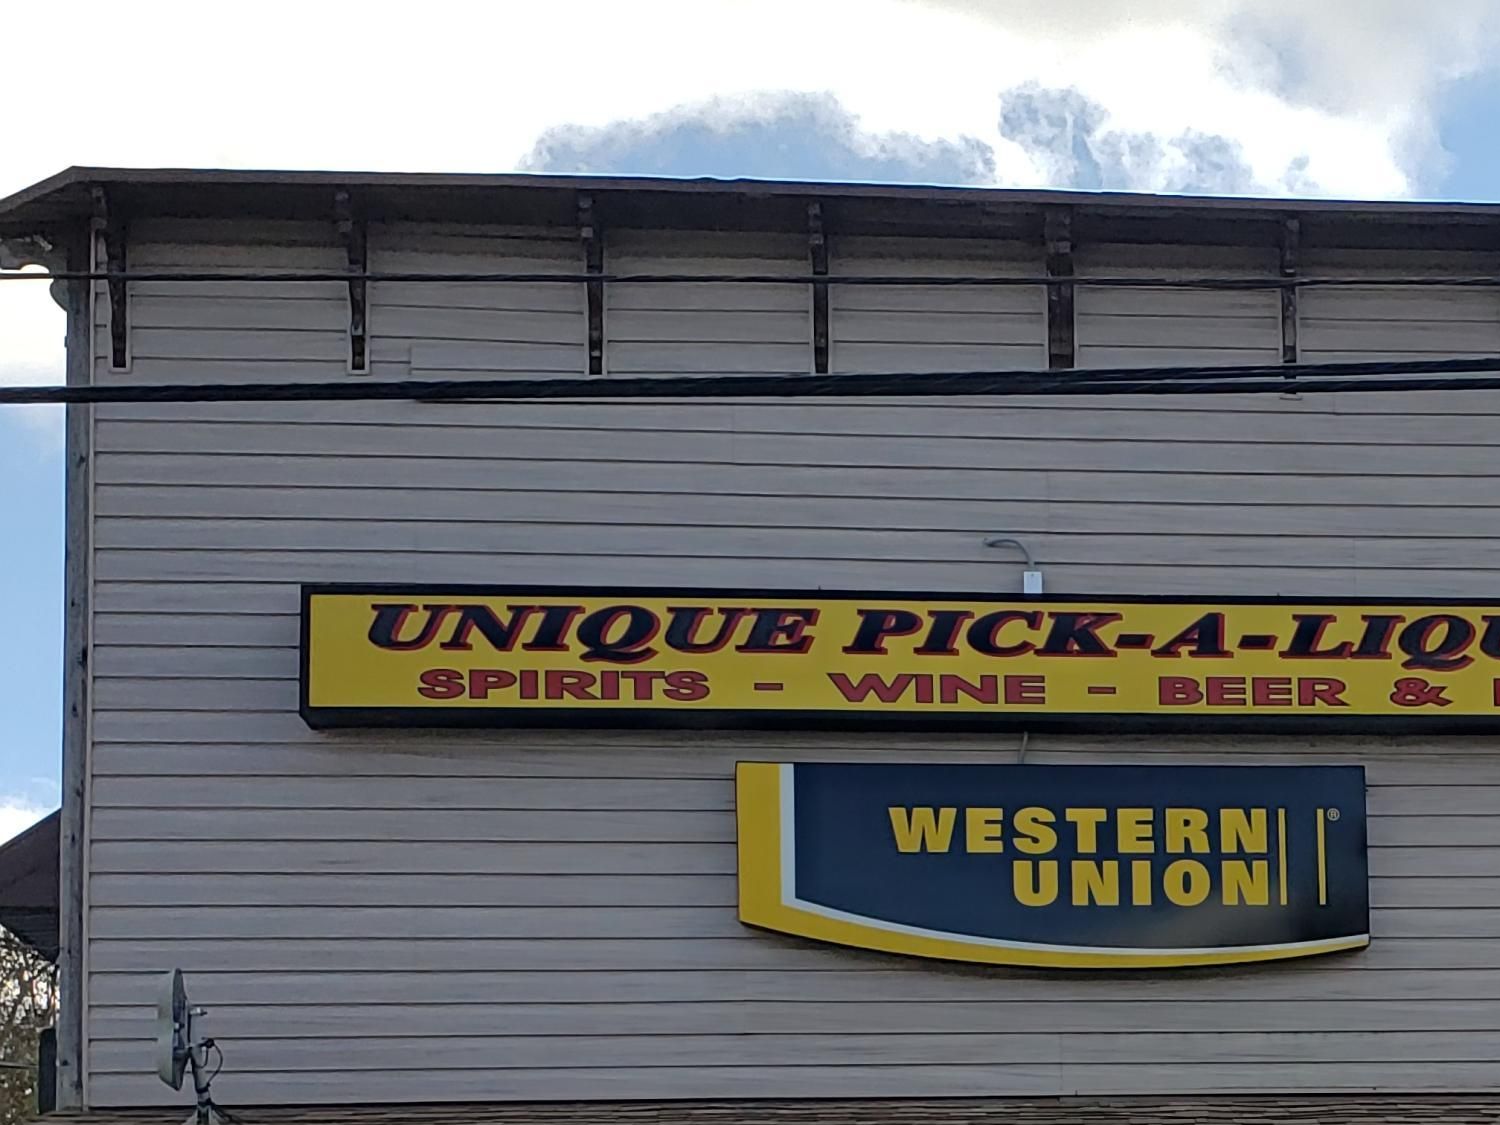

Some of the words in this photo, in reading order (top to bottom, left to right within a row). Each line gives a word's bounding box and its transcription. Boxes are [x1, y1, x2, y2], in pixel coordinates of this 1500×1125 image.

[367, 603, 820, 664] UNIQUE
[418, 668, 710, 701] SPIRITS
[826, 673, 1046, 704] WINE
[1158, 676, 1350, 707] BEER
[1389, 677, 1452, 707] &
[889, 806, 1268, 854] WESTERN
[1013, 860, 1268, 906] UNION
